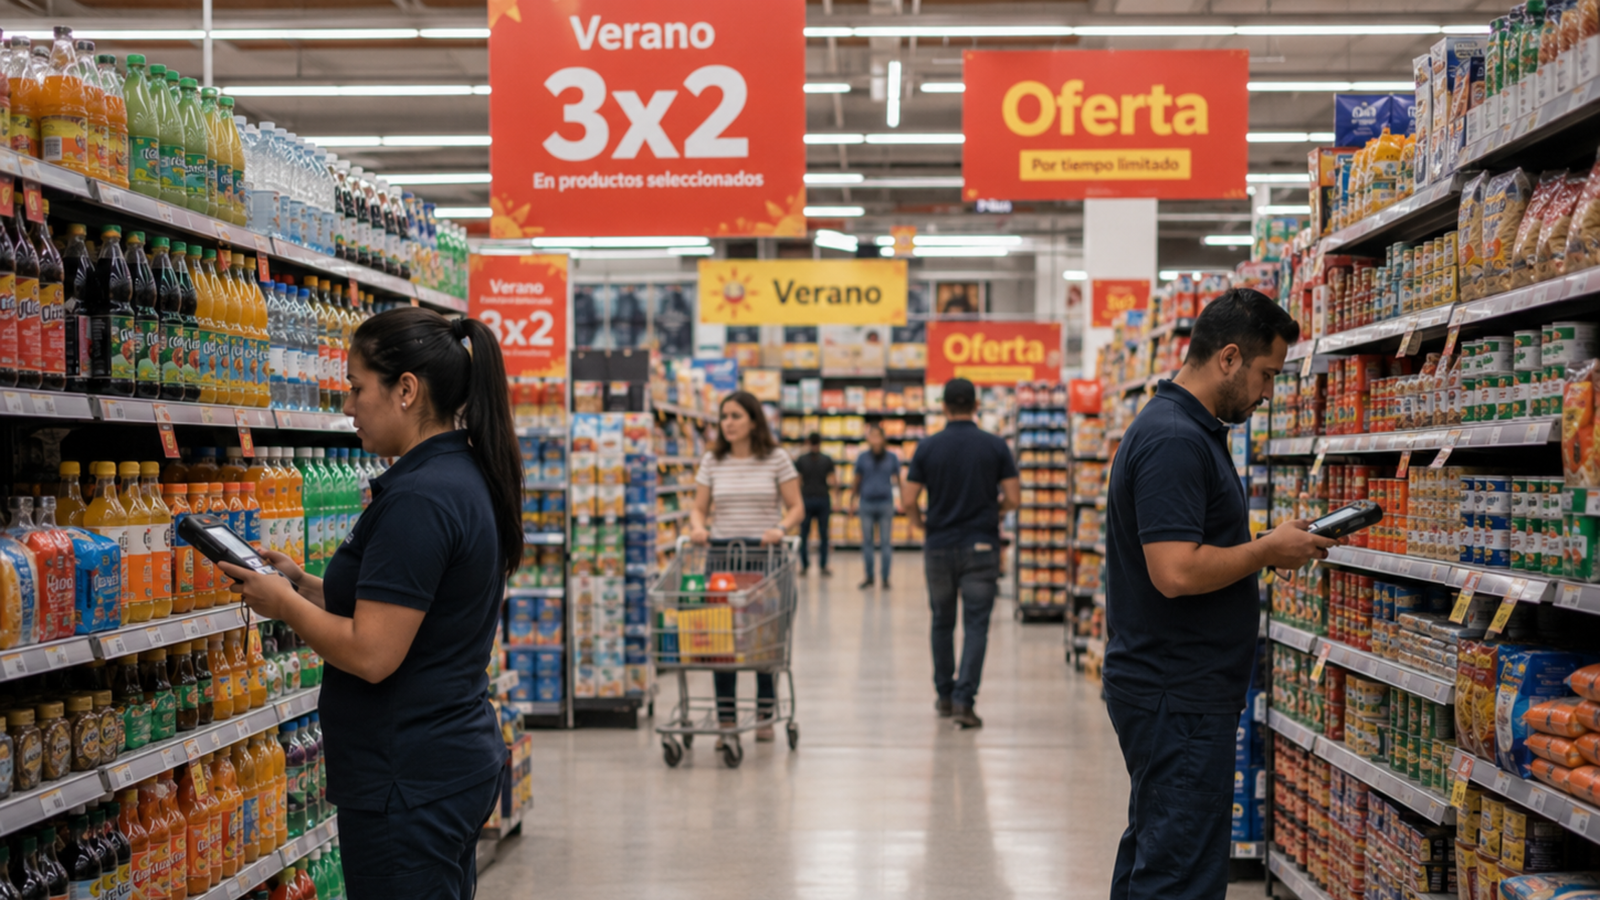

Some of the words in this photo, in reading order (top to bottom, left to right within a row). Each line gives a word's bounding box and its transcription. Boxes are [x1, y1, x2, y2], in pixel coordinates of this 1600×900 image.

[569, 15, 715, 50] Verano
[542, 65, 749, 161] 3x2
[1002, 79, 1209, 137] Oferta
[533, 173, 554, 189] En
[558, 172, 643, 192] productos
[646, 170, 764, 188] seleccionados
[1031, 158, 1056, 171] Por
[1061, 157, 1114, 174] tiempo
[1117, 156, 1180, 171] limitado
[489, 278, 544, 295] Verano
[773, 279, 882, 305] Verano
[479, 309, 554, 346] 3x2
[943, 332, 1045, 364] Oferta
